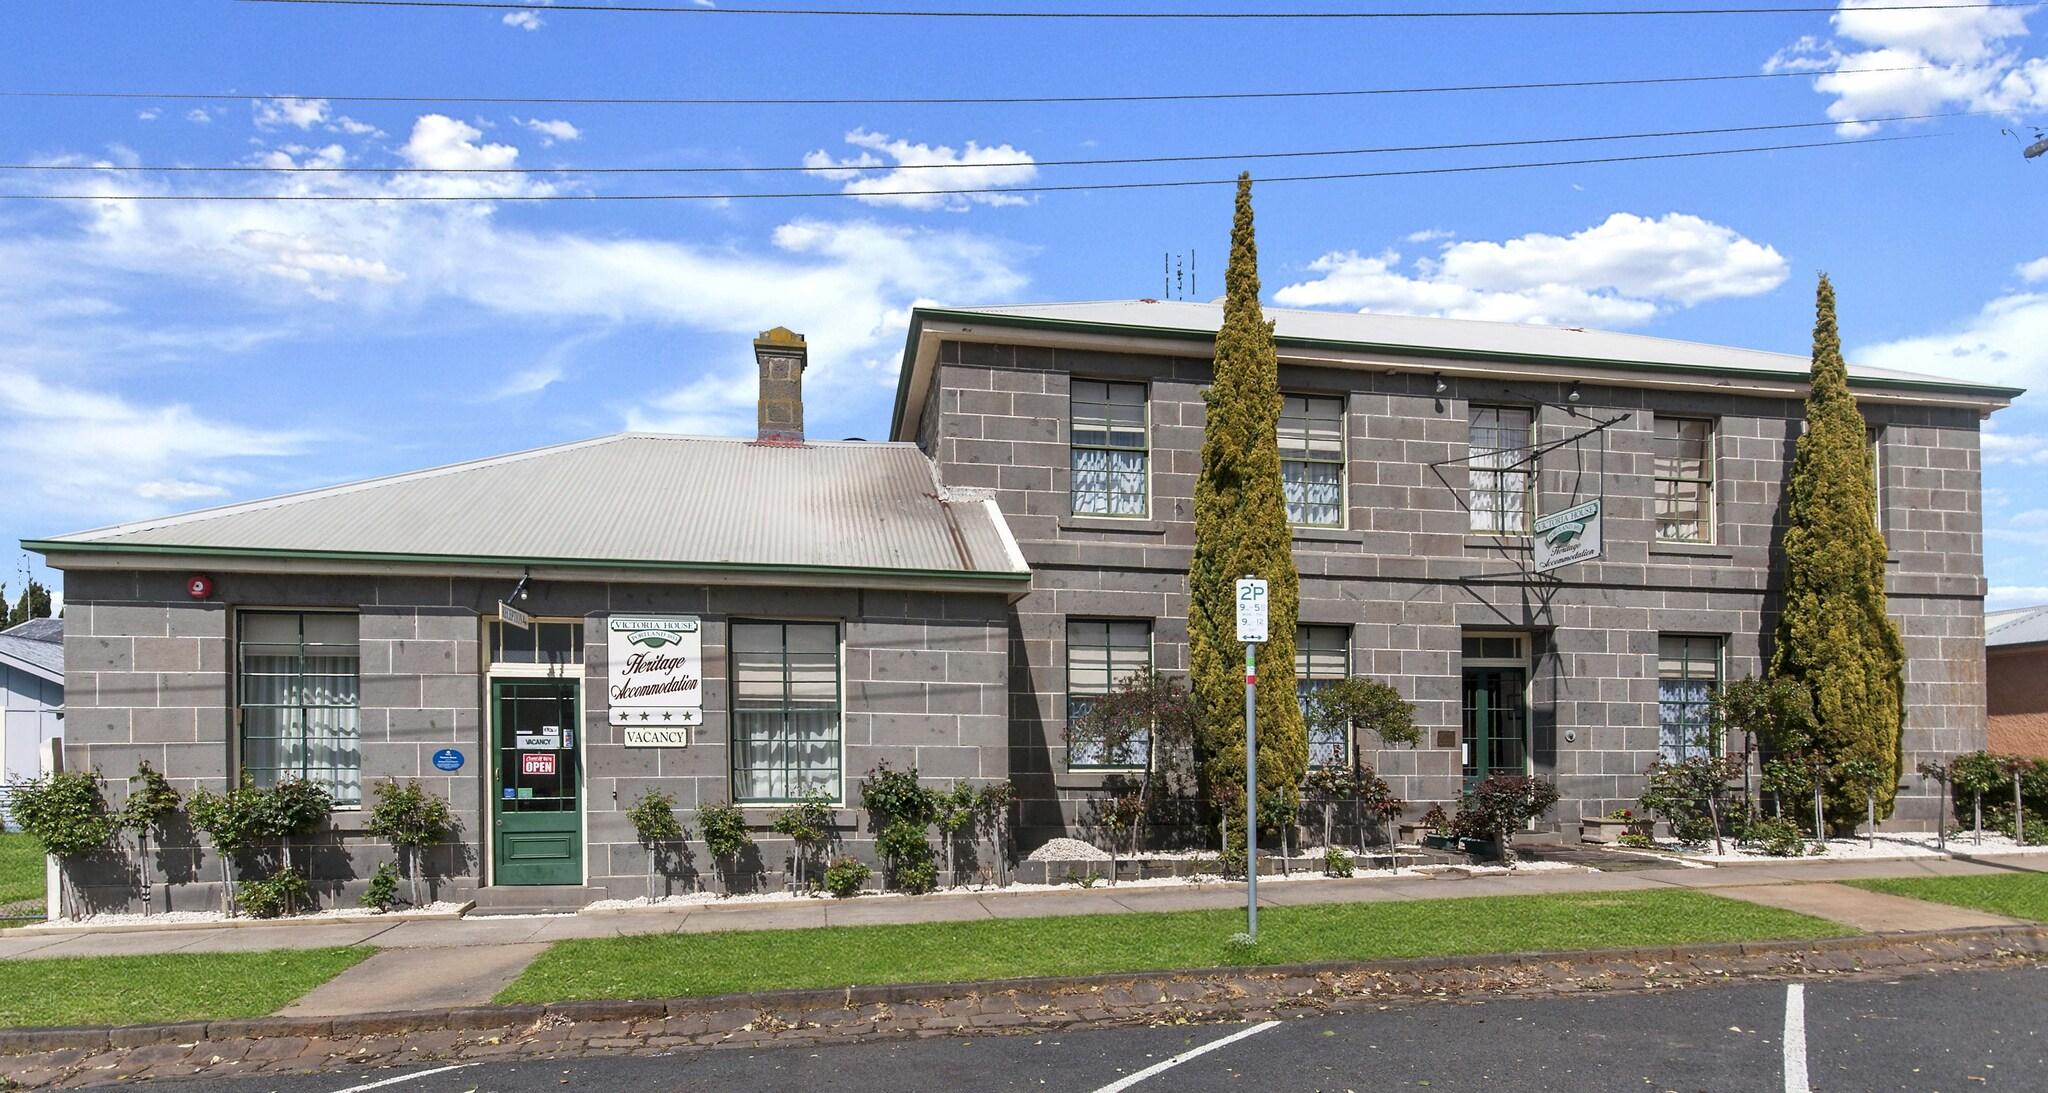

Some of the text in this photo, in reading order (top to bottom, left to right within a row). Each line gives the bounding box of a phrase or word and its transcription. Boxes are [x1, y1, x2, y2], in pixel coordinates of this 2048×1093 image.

[1241, 586, 1264, 600] 2P
[615, 621, 693, 629] VICTORIA HOUSE
[622, 651, 686, 675] Heritage
[610, 675, 698, 700] Accommodation
[627, 731, 684, 743] VACANCY
[526, 761, 552, 772] OPEN
